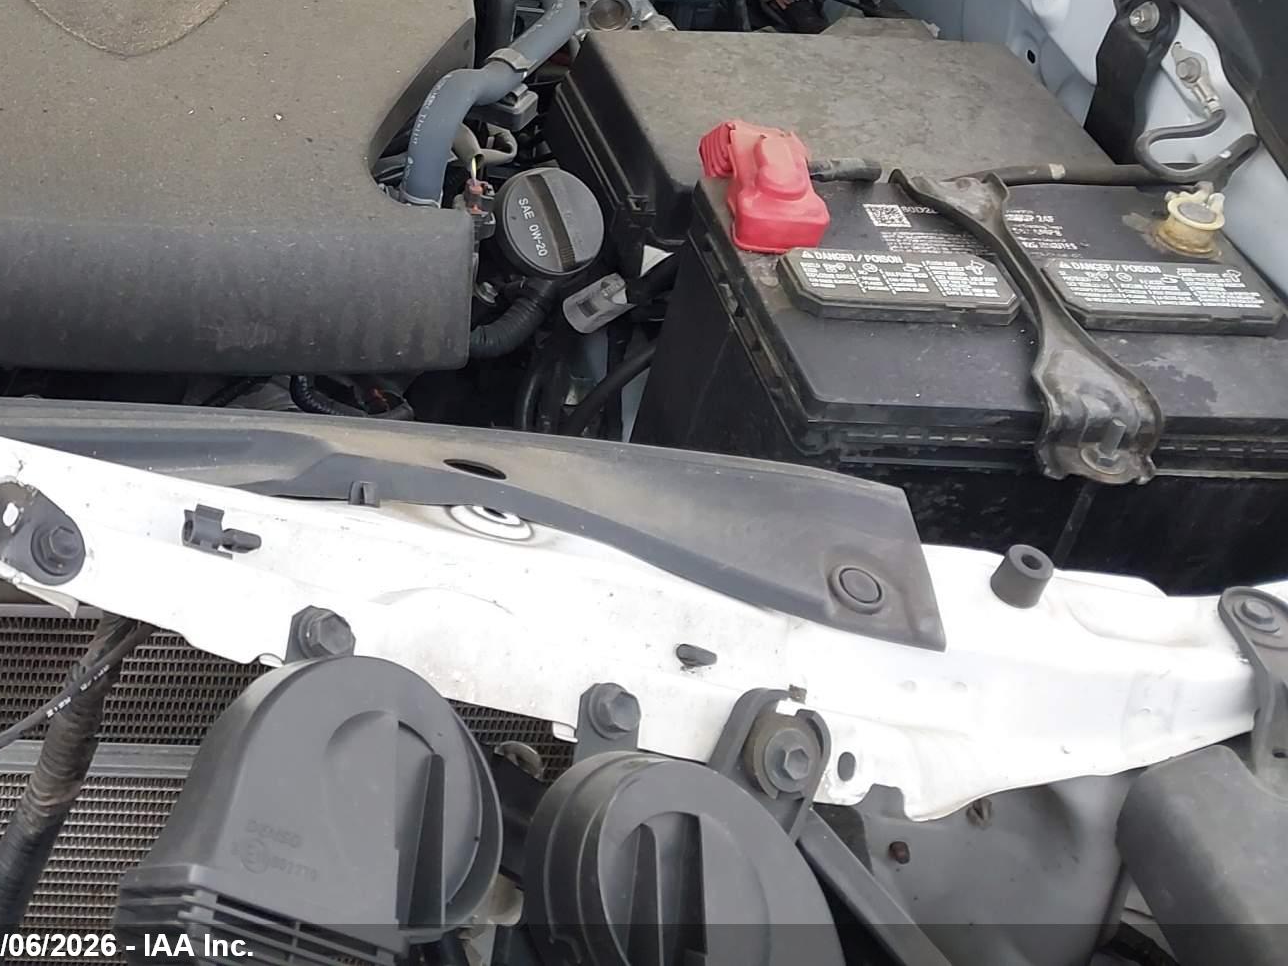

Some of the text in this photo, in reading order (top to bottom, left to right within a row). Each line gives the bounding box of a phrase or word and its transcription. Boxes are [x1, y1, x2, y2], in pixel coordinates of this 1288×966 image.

[518, 197, 548, 256] SAE 0W-20
[814, 251, 856, 262] DANGER
[863, 254, 904, 264] POISON
[1070, 262, 1114, 272] DANGER
[1122, 264, 1162, 274] POISON
